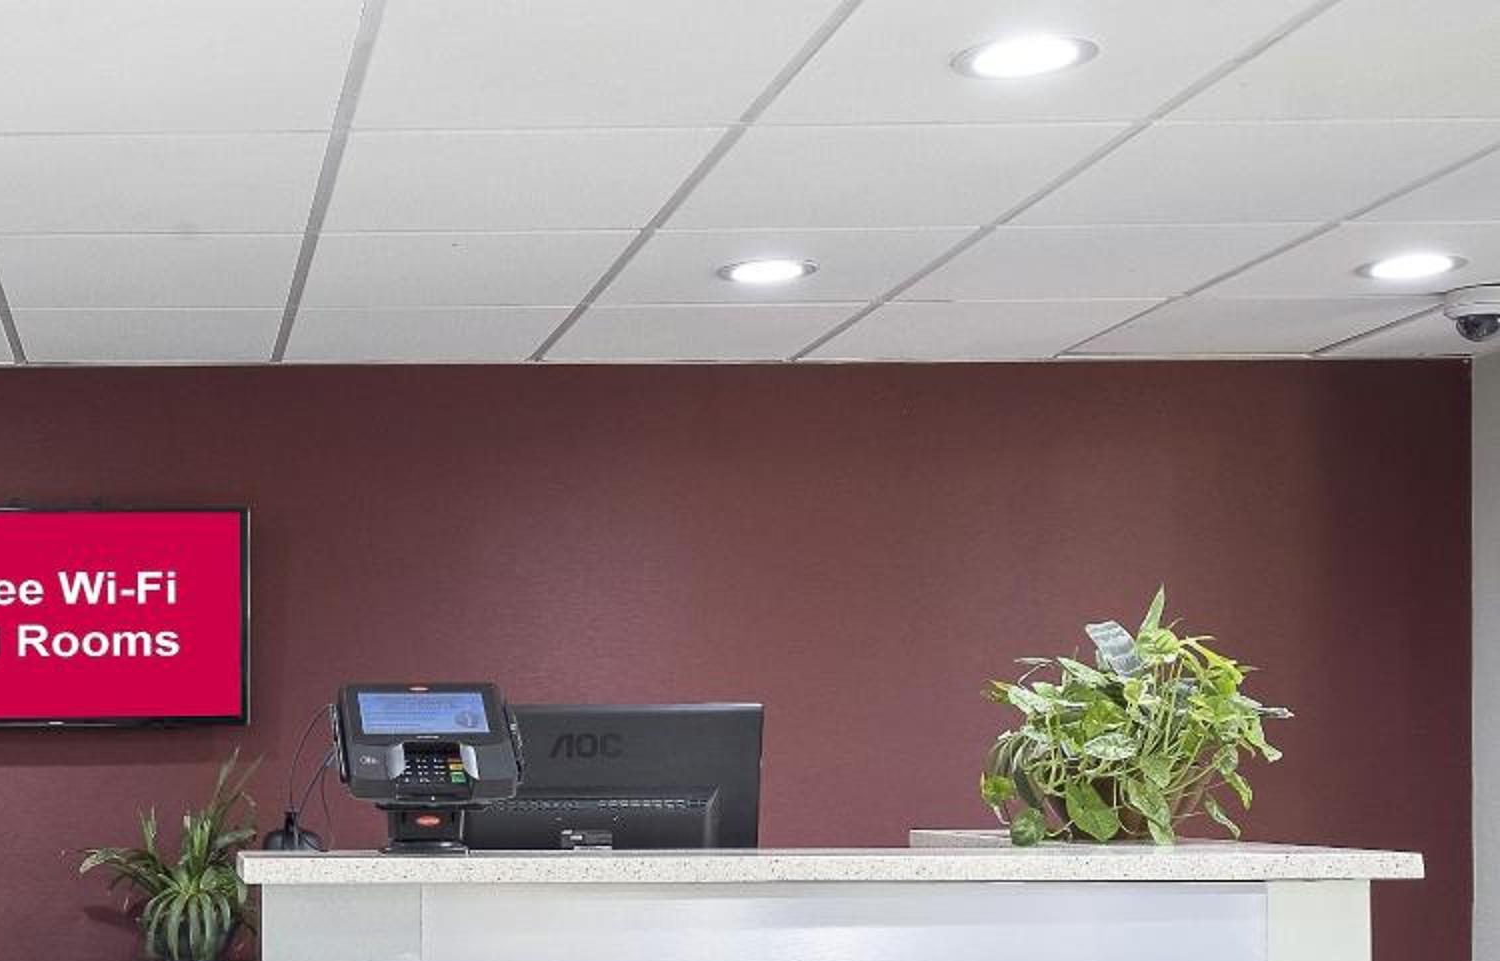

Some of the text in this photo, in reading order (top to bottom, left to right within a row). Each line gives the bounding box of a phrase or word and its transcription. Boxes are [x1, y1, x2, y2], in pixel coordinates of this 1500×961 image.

[58, 571, 178, 605] Wi-Fi
[17, 624, 180, 658] Rooms
[549, 732, 625, 758] AOC
